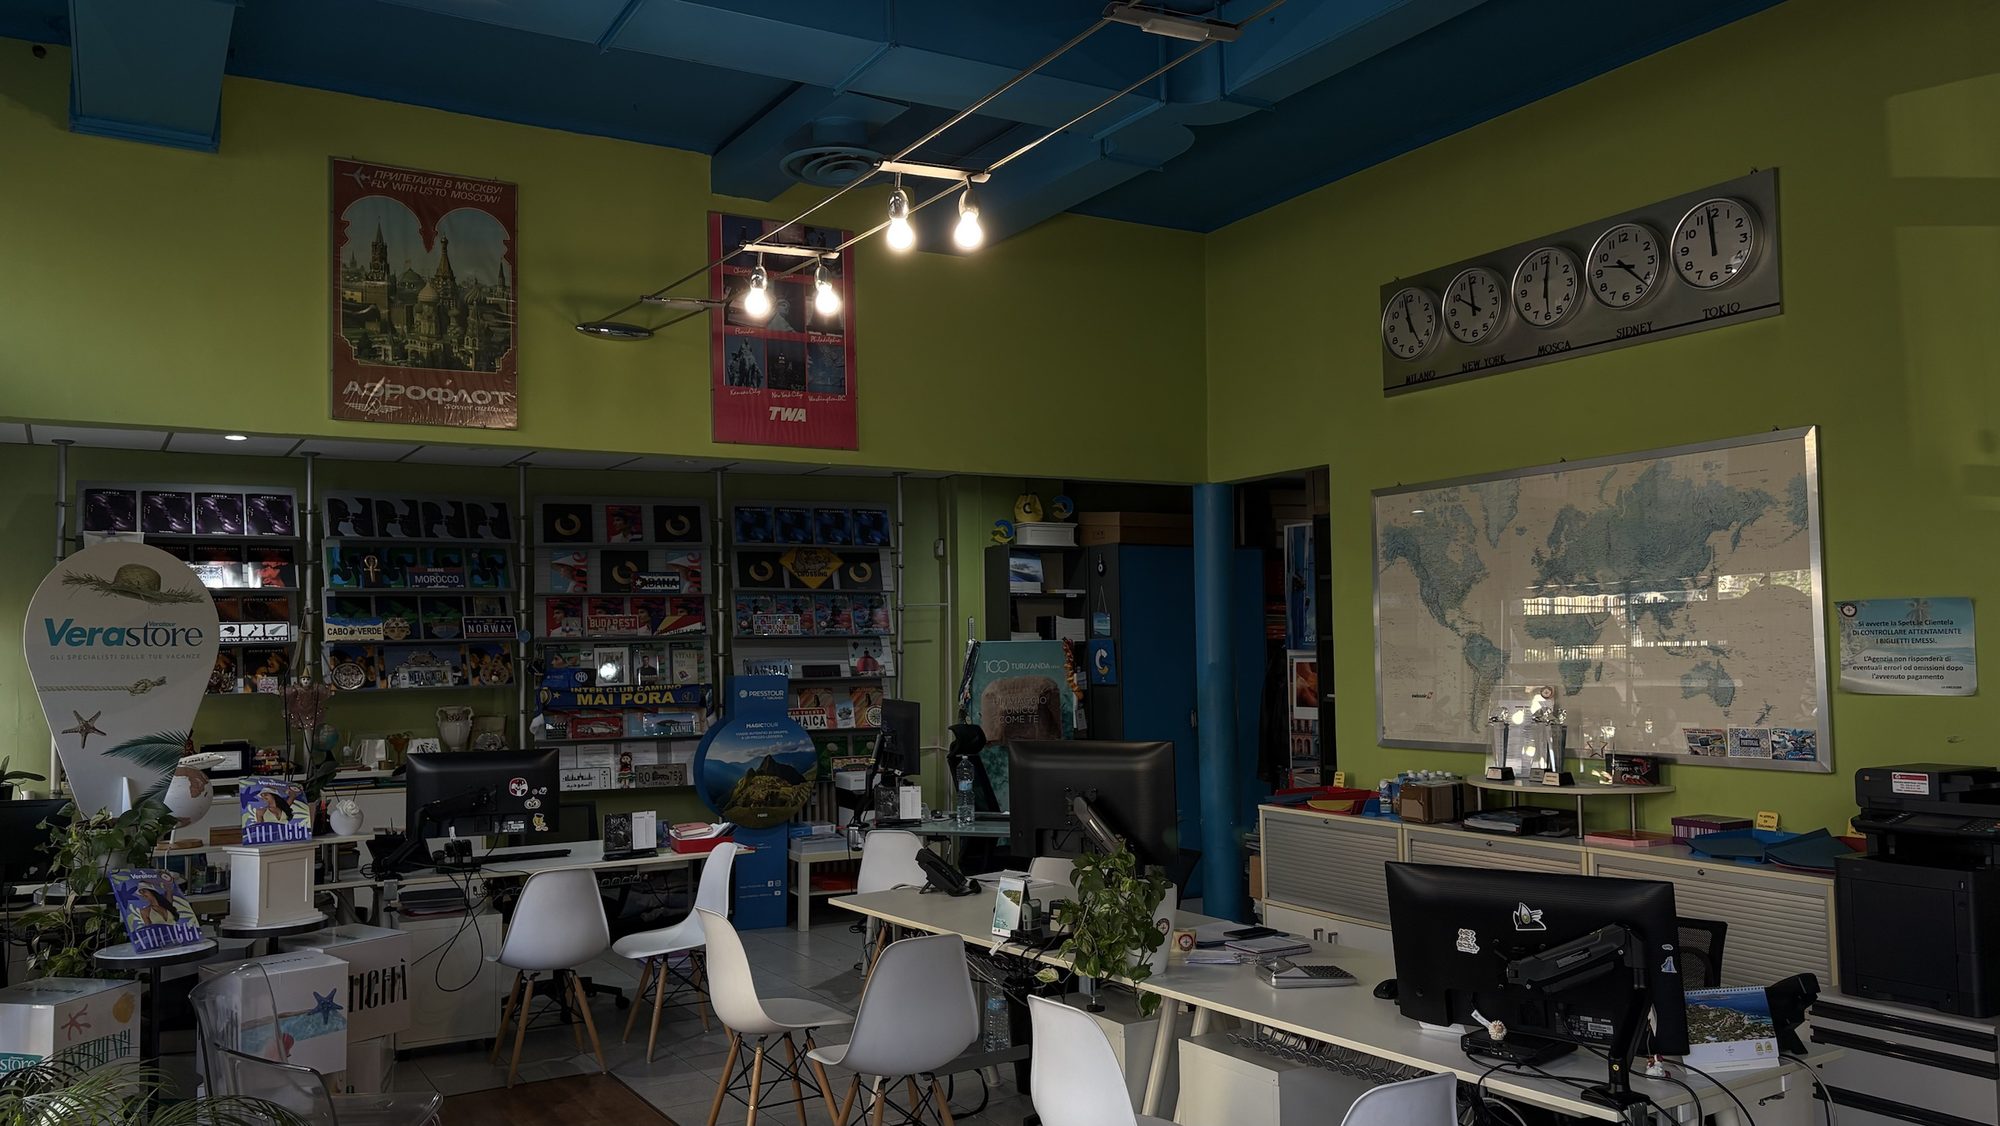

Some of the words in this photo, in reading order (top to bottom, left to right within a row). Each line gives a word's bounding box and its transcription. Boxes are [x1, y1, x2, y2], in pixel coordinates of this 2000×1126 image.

[371, 180, 388, 189] FLY
[392, 183, 417, 192] WITH
[419, 186, 434, 195] US
[434, 189, 446, 197] TO
[1703, 303, 1740, 319] TOKIO
[1616, 321, 1652, 339] SIDNEY
[1538, 341, 1571, 355] MOSCA
[1462, 360, 1481, 372] NEW
[1484, 355, 1506, 367] YORK
[1406, 370, 1435, 384] MILANO
[769, 406, 806, 422] TWA
[415, 575, 459, 584] MOROCCO
[44, 618, 203, 647] Verastore
[328, 628, 348, 636] CABO
[357, 627, 382, 635] VERDE
[468, 624, 512, 633] NORWAY
[984, 660, 1009, 673] 100
[576, 694, 614, 706] MAI
